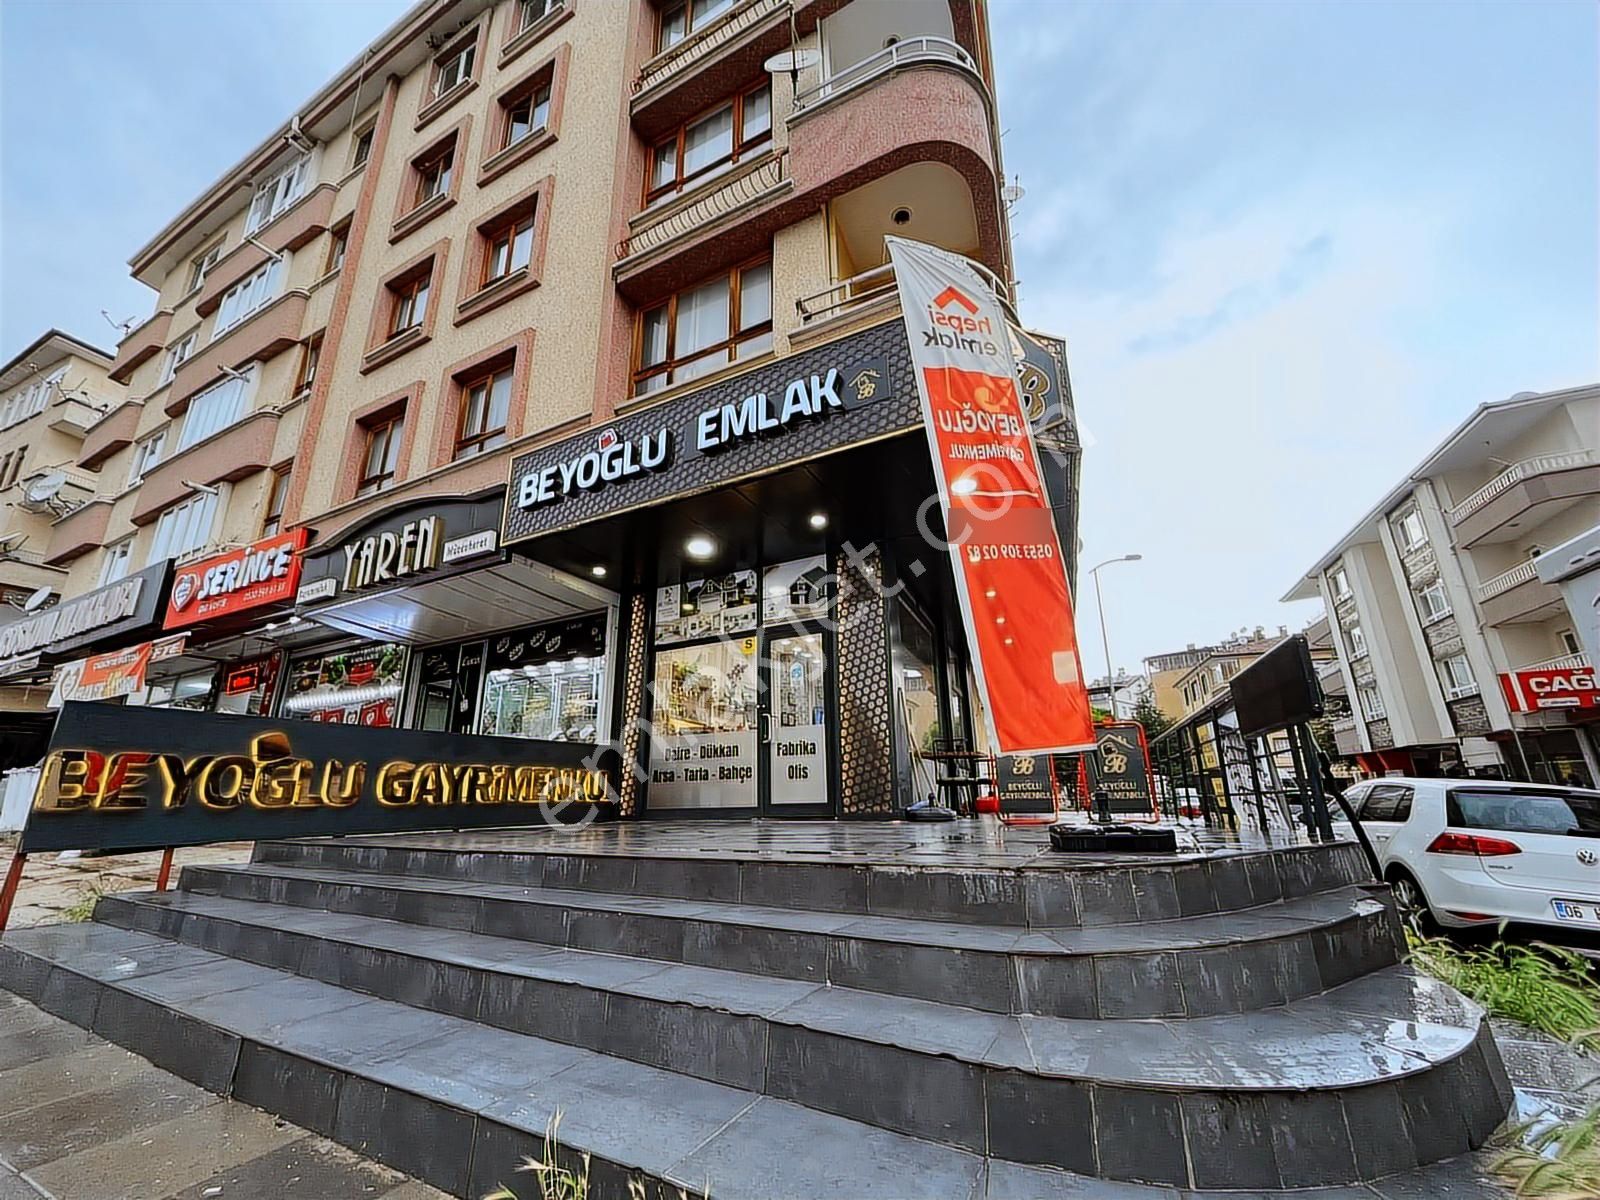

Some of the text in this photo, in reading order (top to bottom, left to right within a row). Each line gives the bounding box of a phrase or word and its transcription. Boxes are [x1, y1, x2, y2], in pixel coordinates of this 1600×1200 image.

[696, 367, 842, 451] EMLAK
[342, 515, 439, 592] YAREN
[197, 542, 294, 600] SERİNCE
[699, 744, 739, 760] Dükkan
[776, 741, 816, 757] Fabrika
[652, 769, 675, 783] Arsa
[683, 767, 709, 782] Tarla
[718, 765, 752, 784] Bahçe
[1565, 905, 1584, 919] 06
